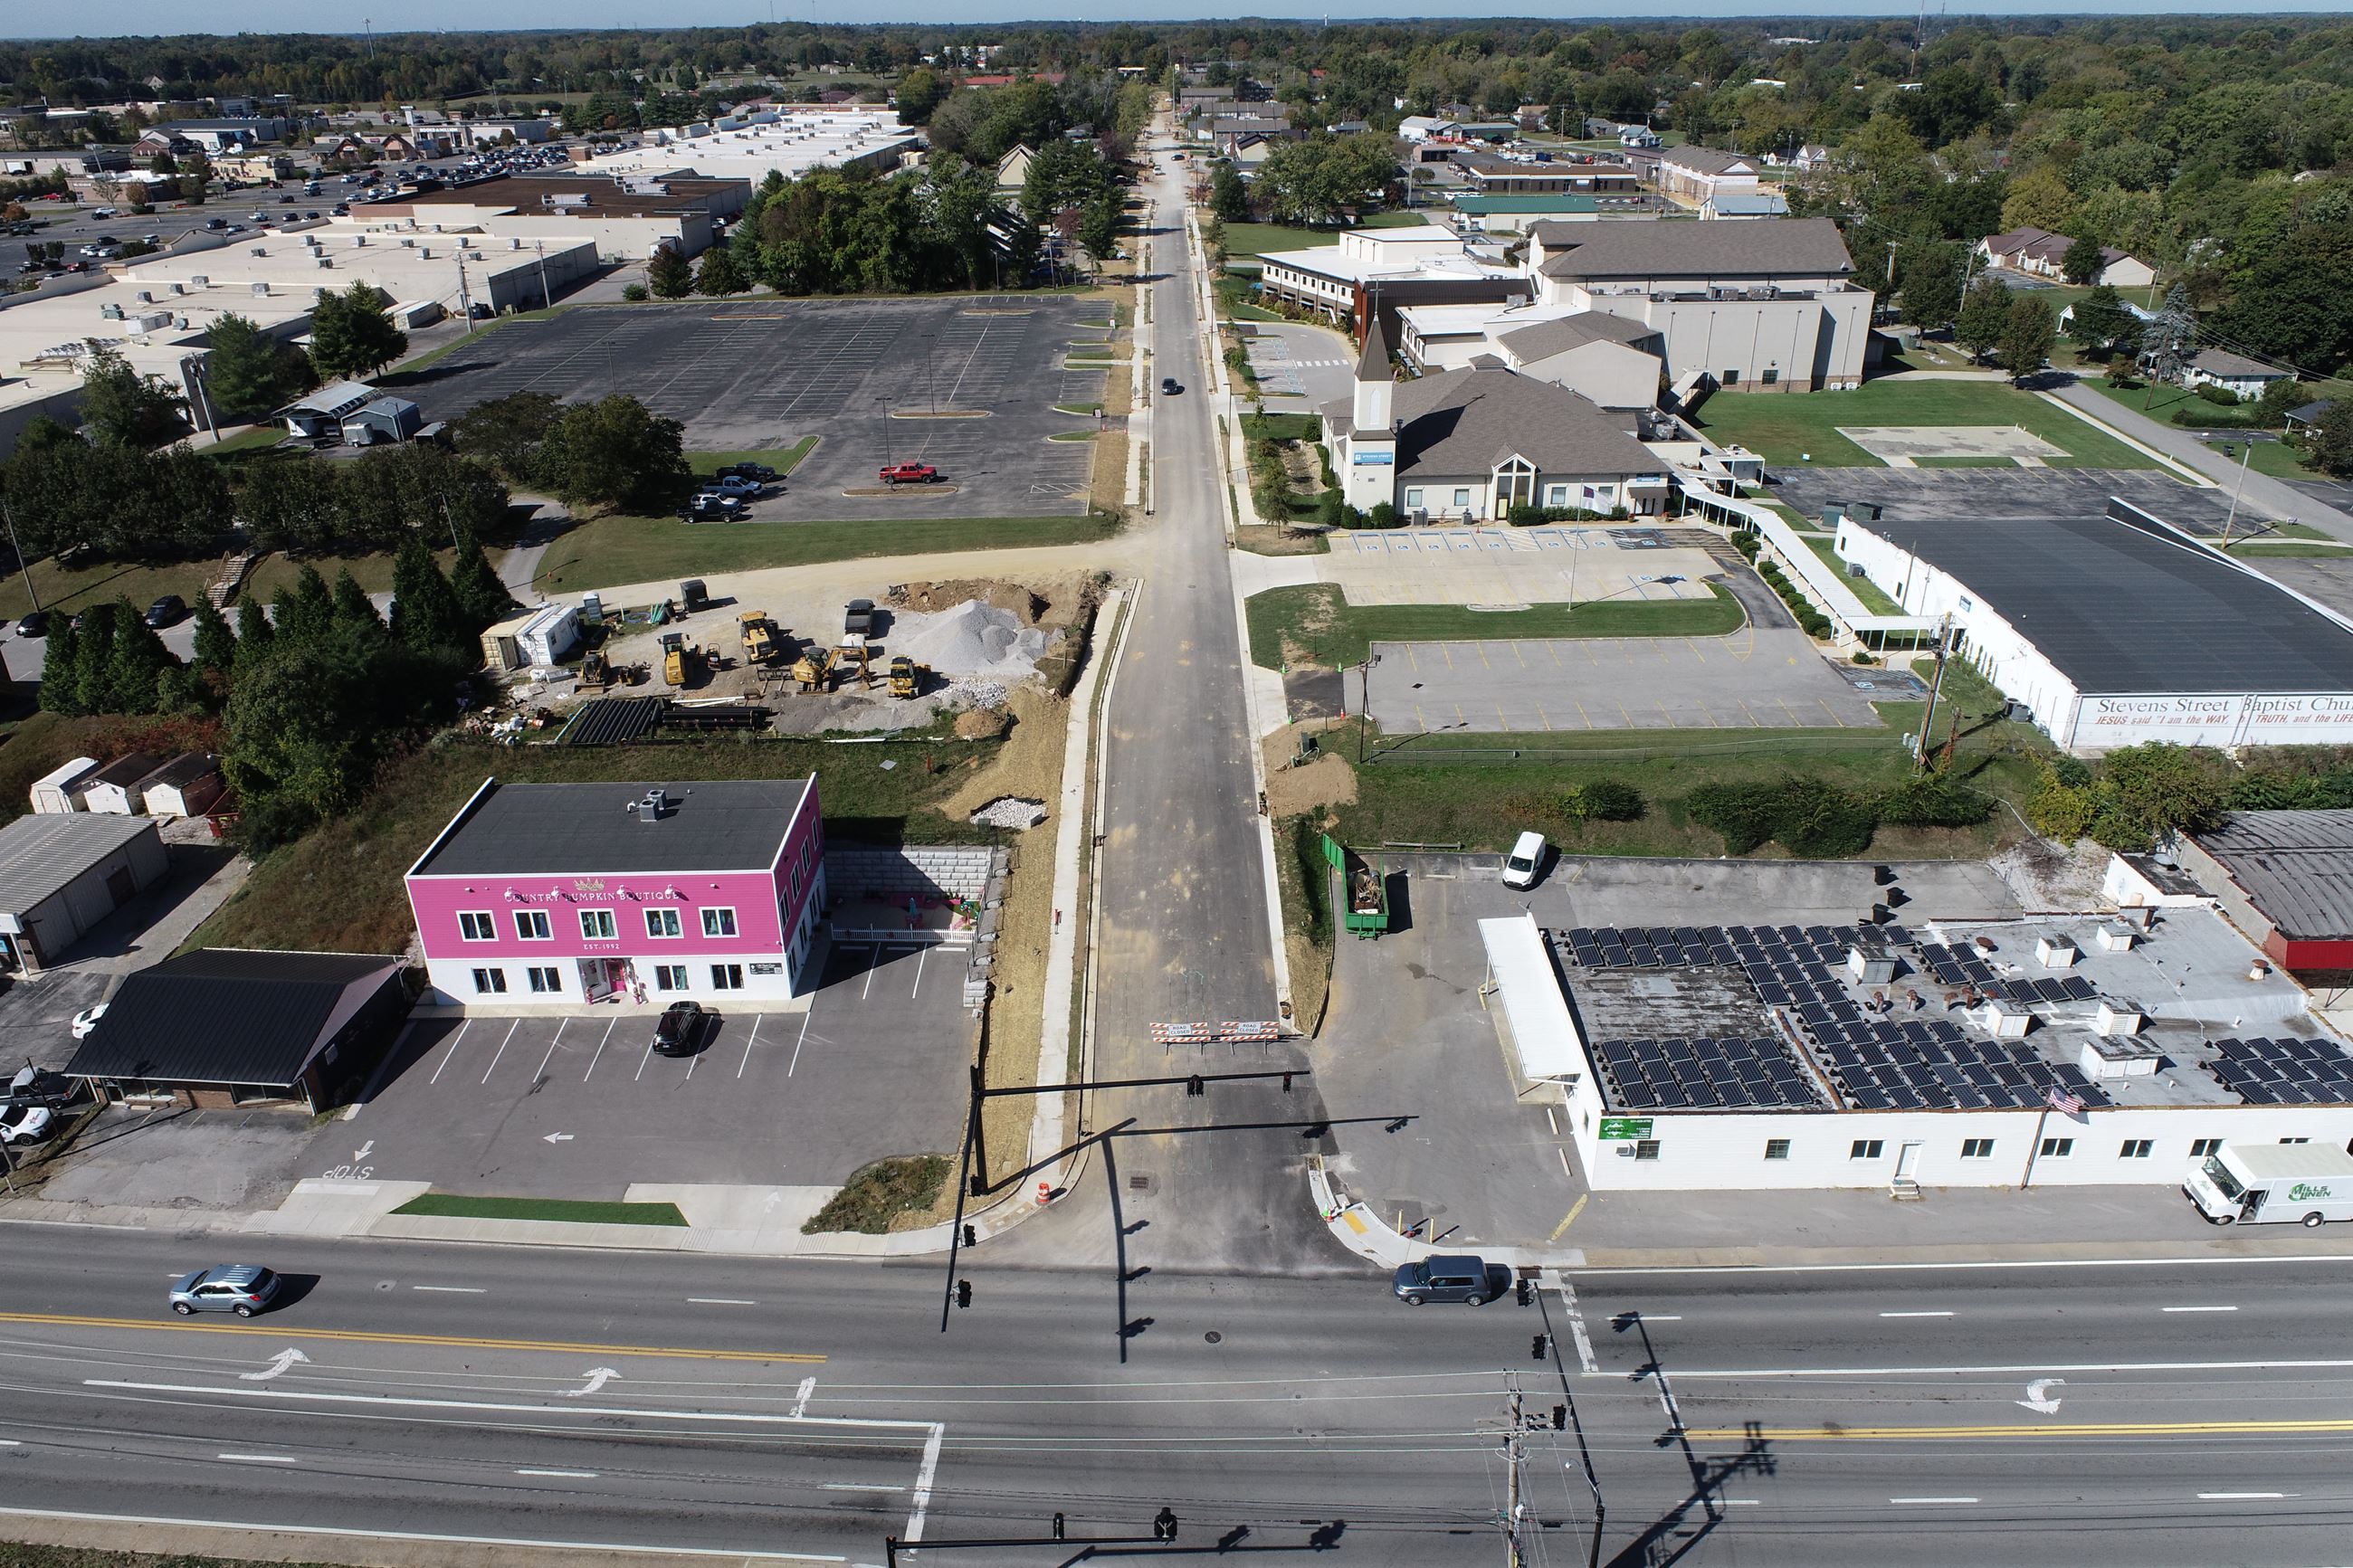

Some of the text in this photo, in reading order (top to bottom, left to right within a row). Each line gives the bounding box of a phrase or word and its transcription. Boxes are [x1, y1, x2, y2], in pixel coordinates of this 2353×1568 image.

[2097, 698, 2168, 713] Stevens
[2175, 698, 2230, 712] Street
[2310, 697, 2353, 711] Chu
[2095, 716, 2128, 724] JESUS
[2130, 715, 2152, 724] said
[2186, 715, 2202, 724] the
[2205, 715, 2229, 725] WAY,
[2255, 714, 2289, 723] TRUTH,
[2293, 714, 2312, 723] and
[2314, 714, 2330, 723] the
[321, 1164, 375, 1180] STOP
[2290, 1183, 2329, 1194] MILLS
[2300, 1191, 2331, 1200] LINEN
